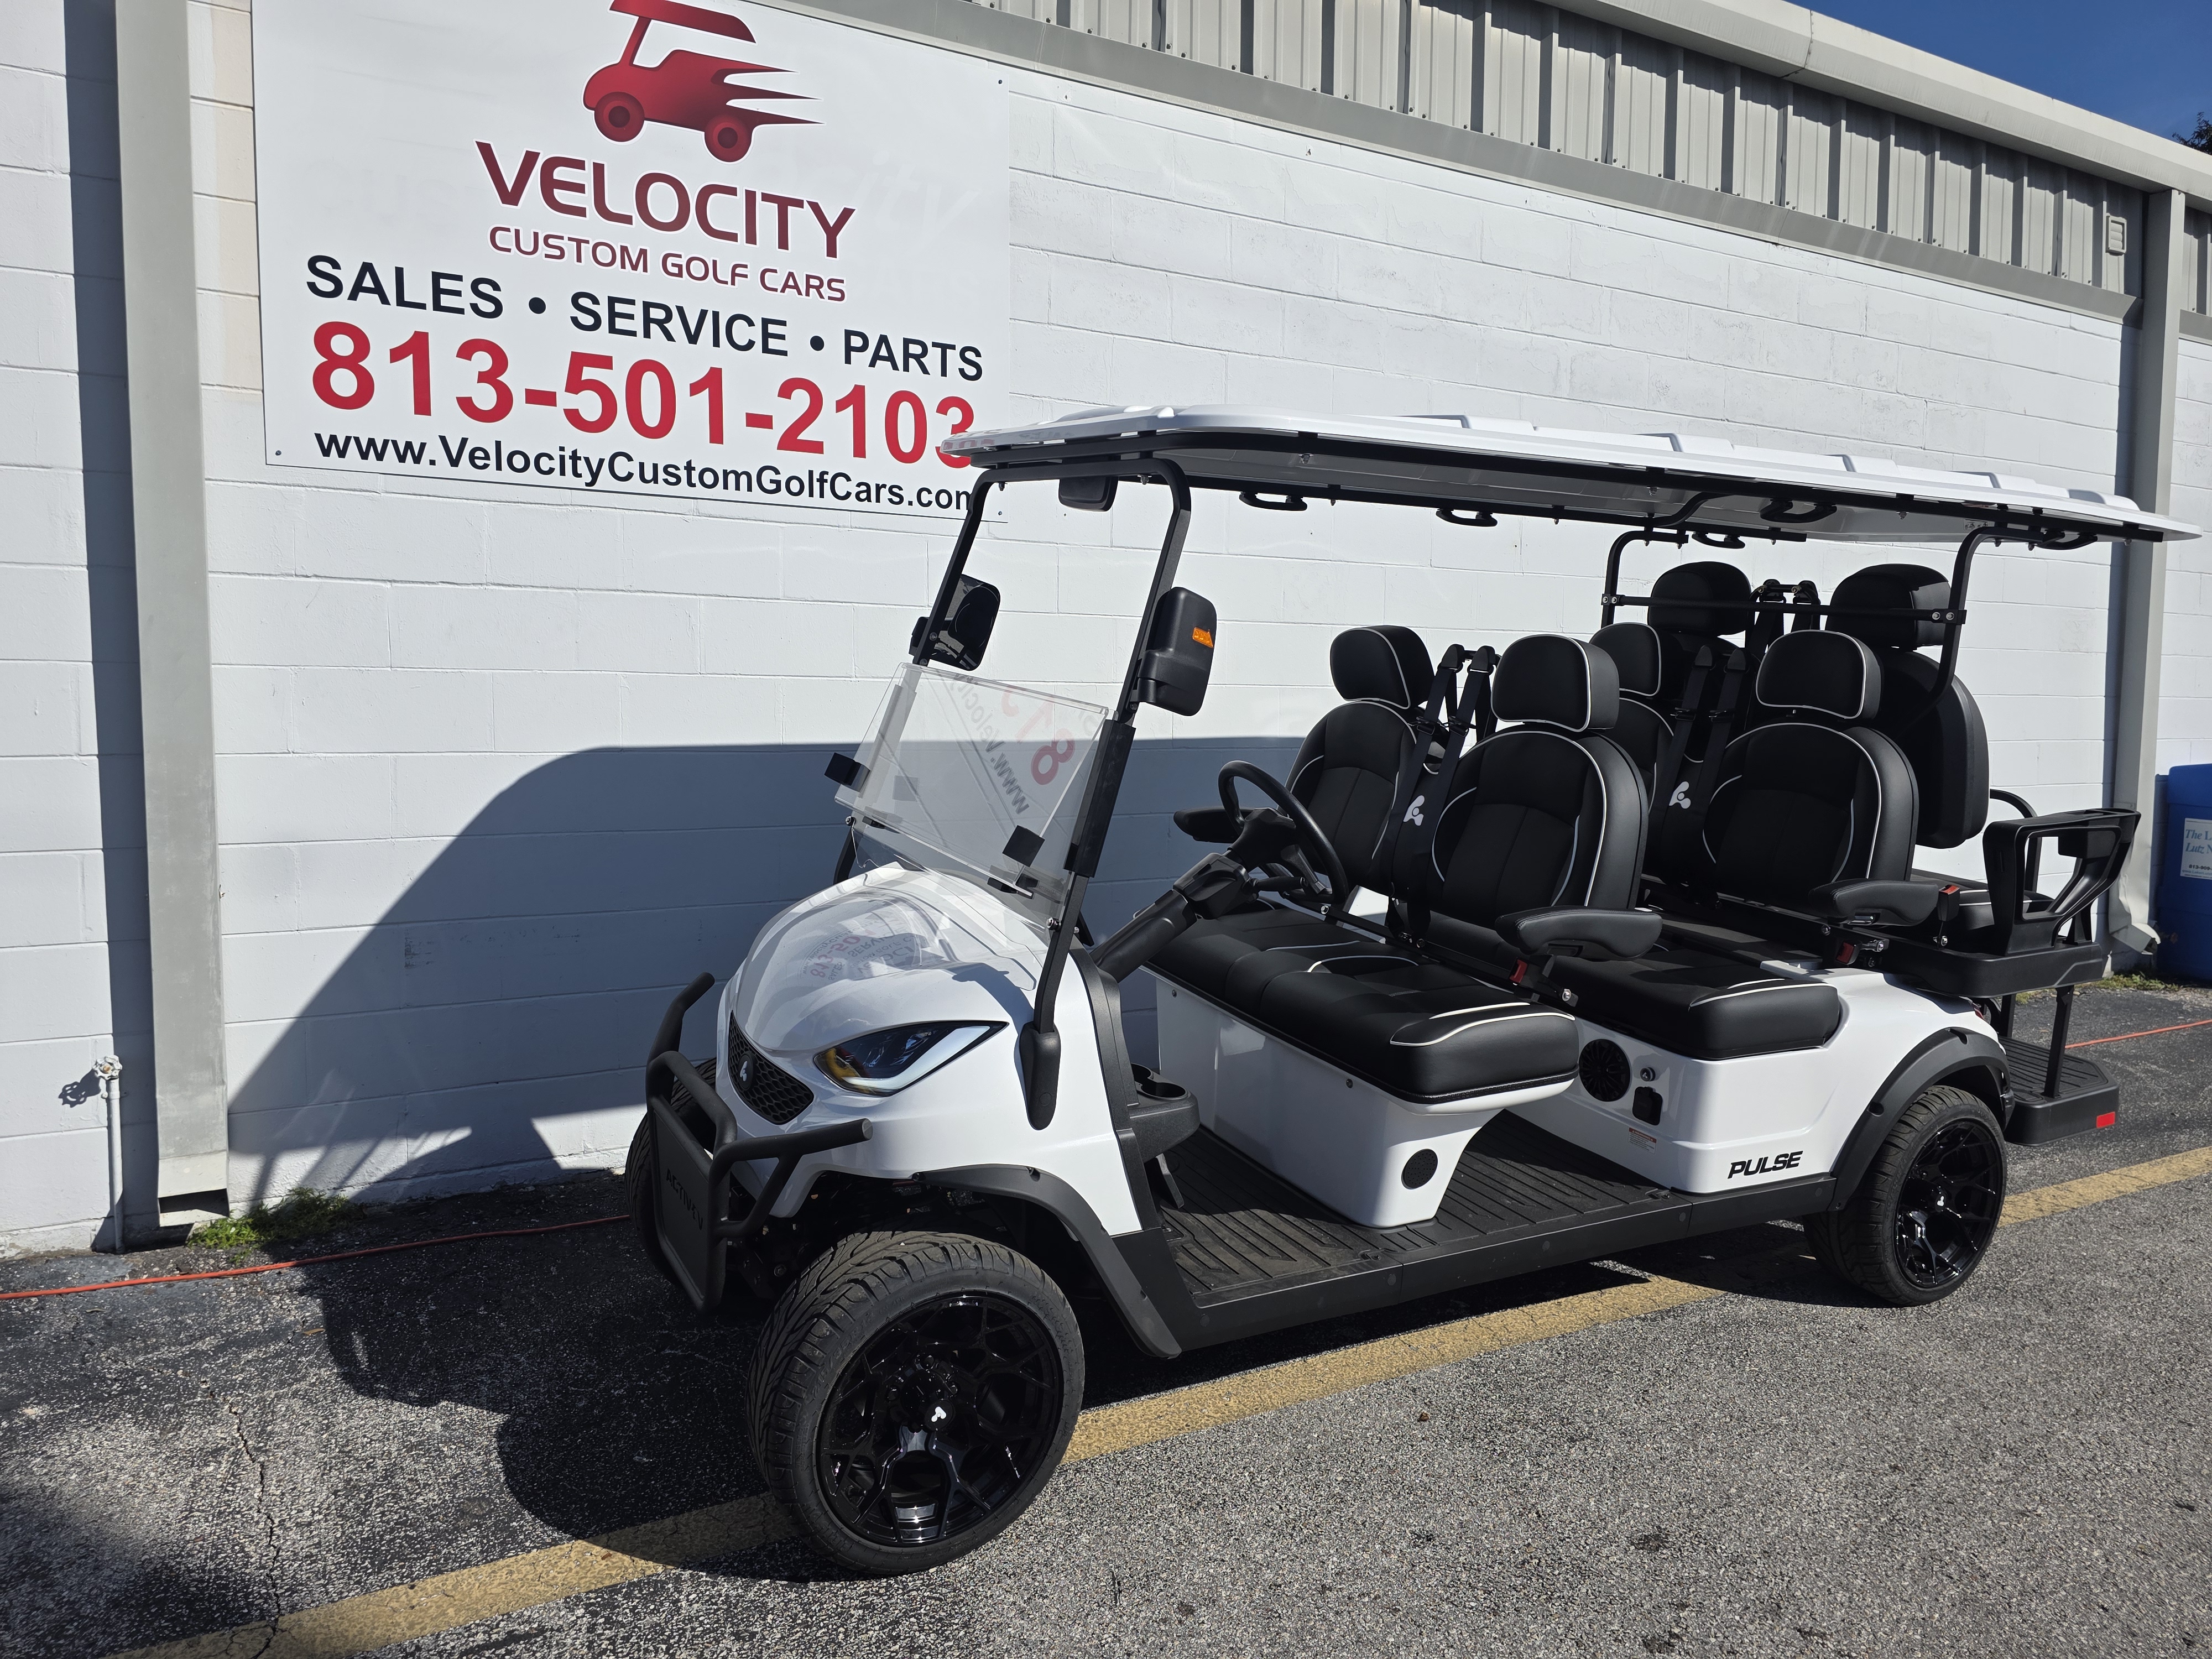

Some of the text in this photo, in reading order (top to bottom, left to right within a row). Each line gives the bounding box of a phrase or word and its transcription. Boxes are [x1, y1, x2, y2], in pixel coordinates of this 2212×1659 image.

[475, 140, 856, 259] VELOCITY
[489, 226, 648, 273] CUSTOM
[661, 253, 748, 286] GOLF
[760, 268, 846, 302] CARS
[306, 255, 983, 381] SALES SERVICE PARTS
[312, 321, 974, 469] 813-501-2103
[2185, 829, 2203, 839] The
[2185, 842, 2205, 854] Lutz
[1727, 1150, 1803, 1179] PULSE
